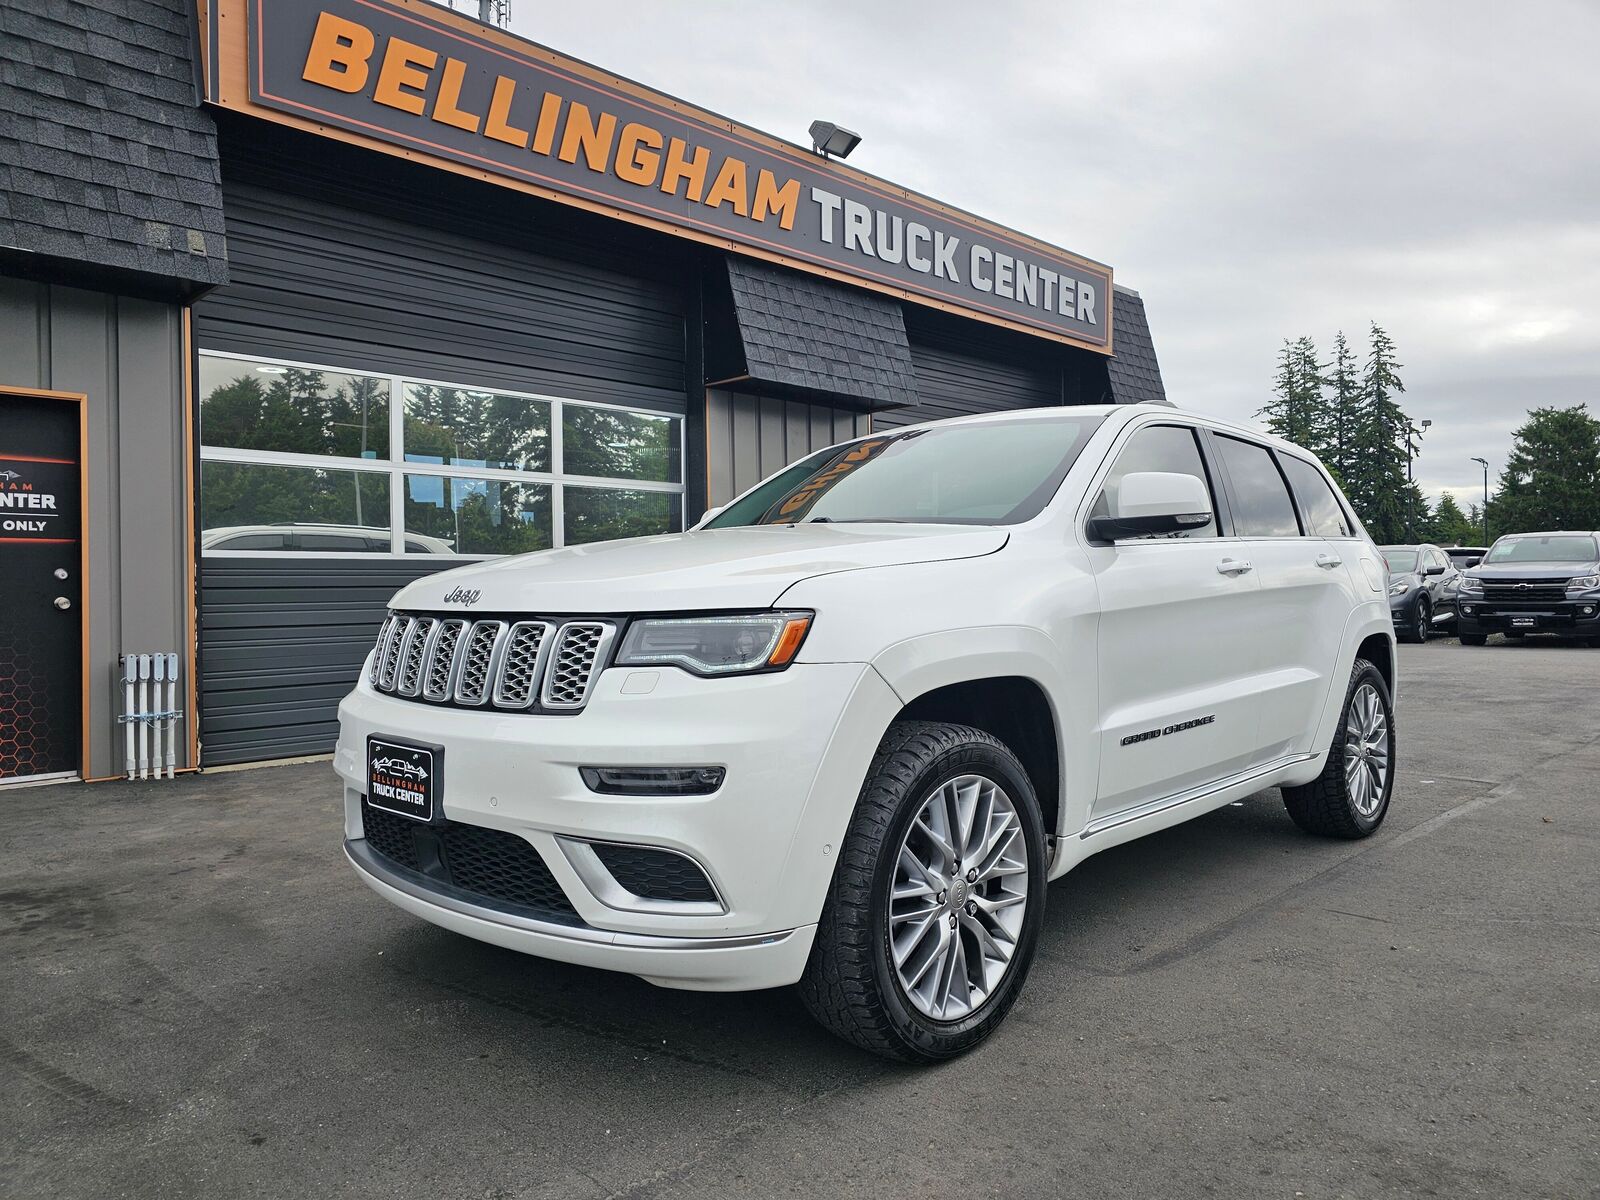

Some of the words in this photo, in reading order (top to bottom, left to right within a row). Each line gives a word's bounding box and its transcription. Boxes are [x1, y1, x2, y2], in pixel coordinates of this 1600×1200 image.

[302, 11, 801, 232] BELLINGHAM
[811, 187, 961, 284] TRUCK
[970, 244, 1097, 325] CENTER
[0, 492, 57, 509] NTER
[2, 520, 47, 531] ONLY
[443, 585, 482, 607] Jeep
[1120, 728, 1161, 746] GRAND
[1161, 714, 1216, 736] CHEROKEE
[372, 773, 425, 793] BELLINGHAM
[372, 782, 395, 799] TRUCK
[395, 787, 425, 806] CENTER
